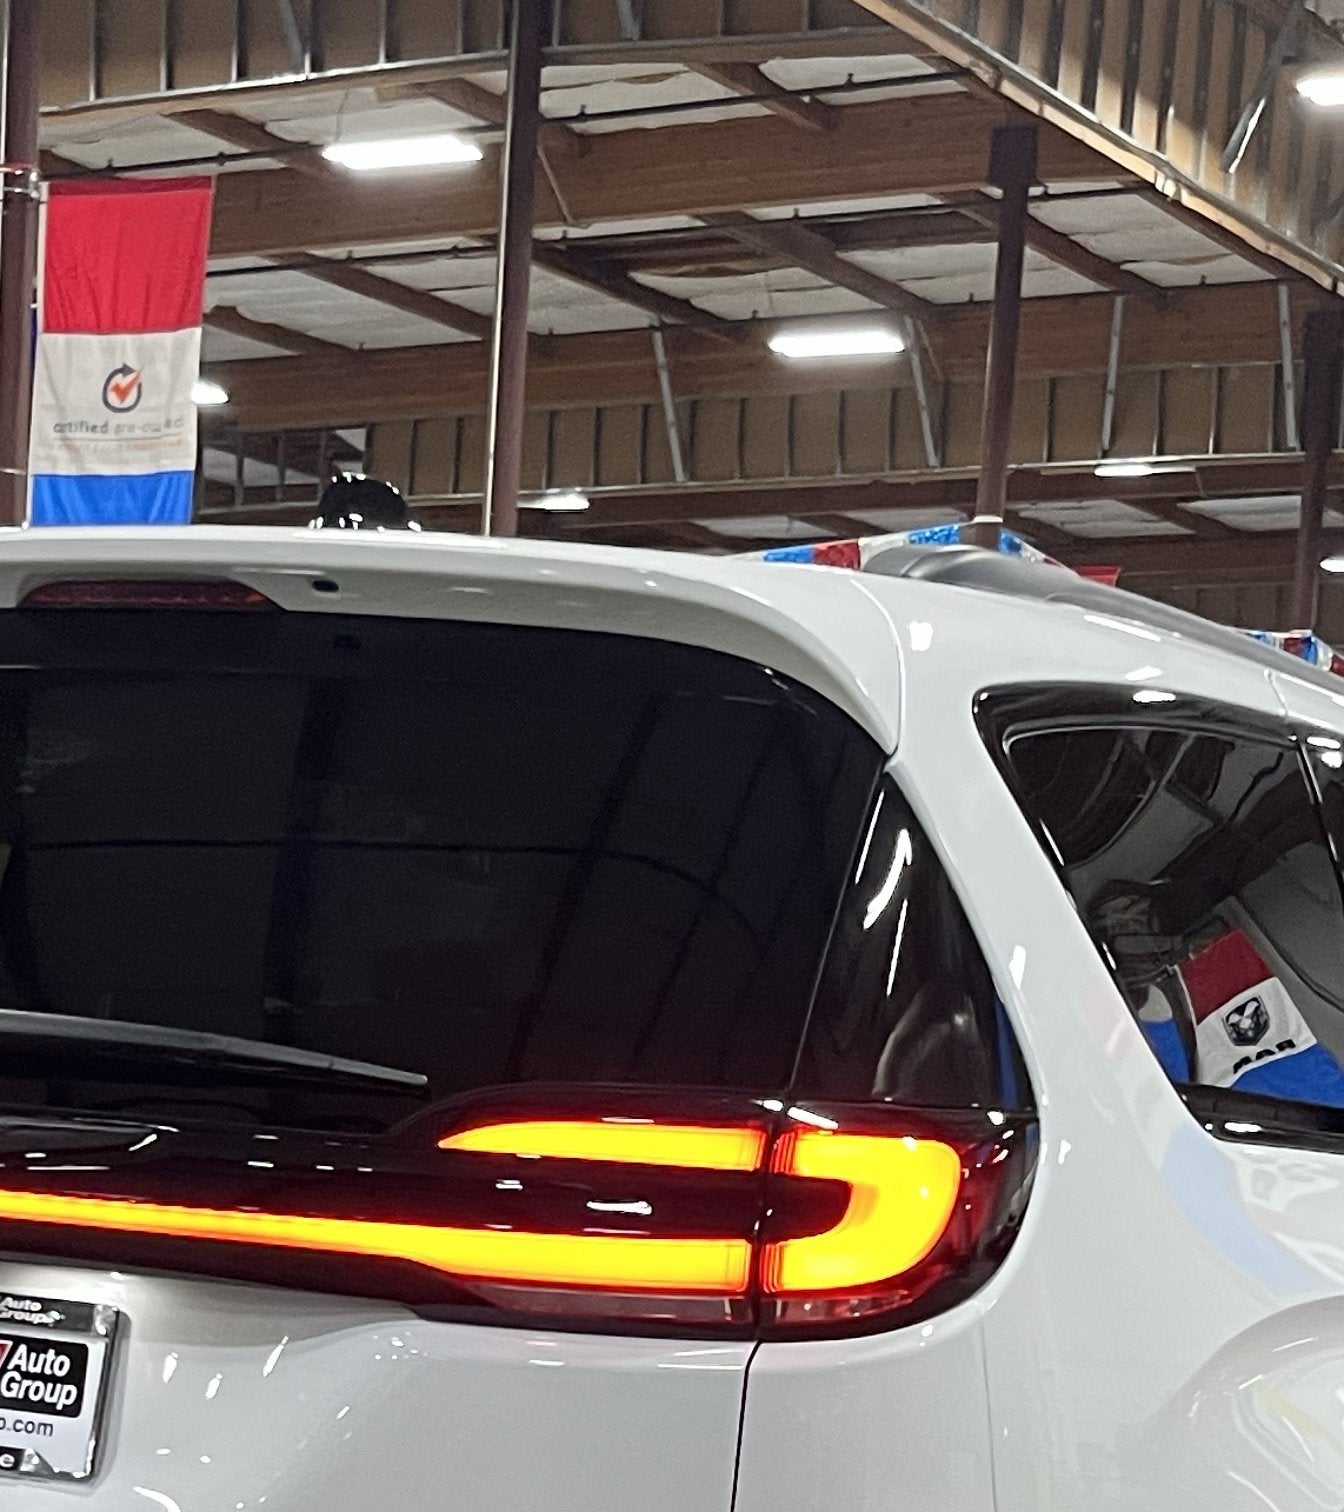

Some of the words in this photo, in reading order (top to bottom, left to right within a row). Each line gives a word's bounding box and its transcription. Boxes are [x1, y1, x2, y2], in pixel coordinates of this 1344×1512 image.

[0, 1296, 42, 1312] Auto
[7, 1344, 71, 1378] Auto
[0, 1371, 77, 1411] Group
